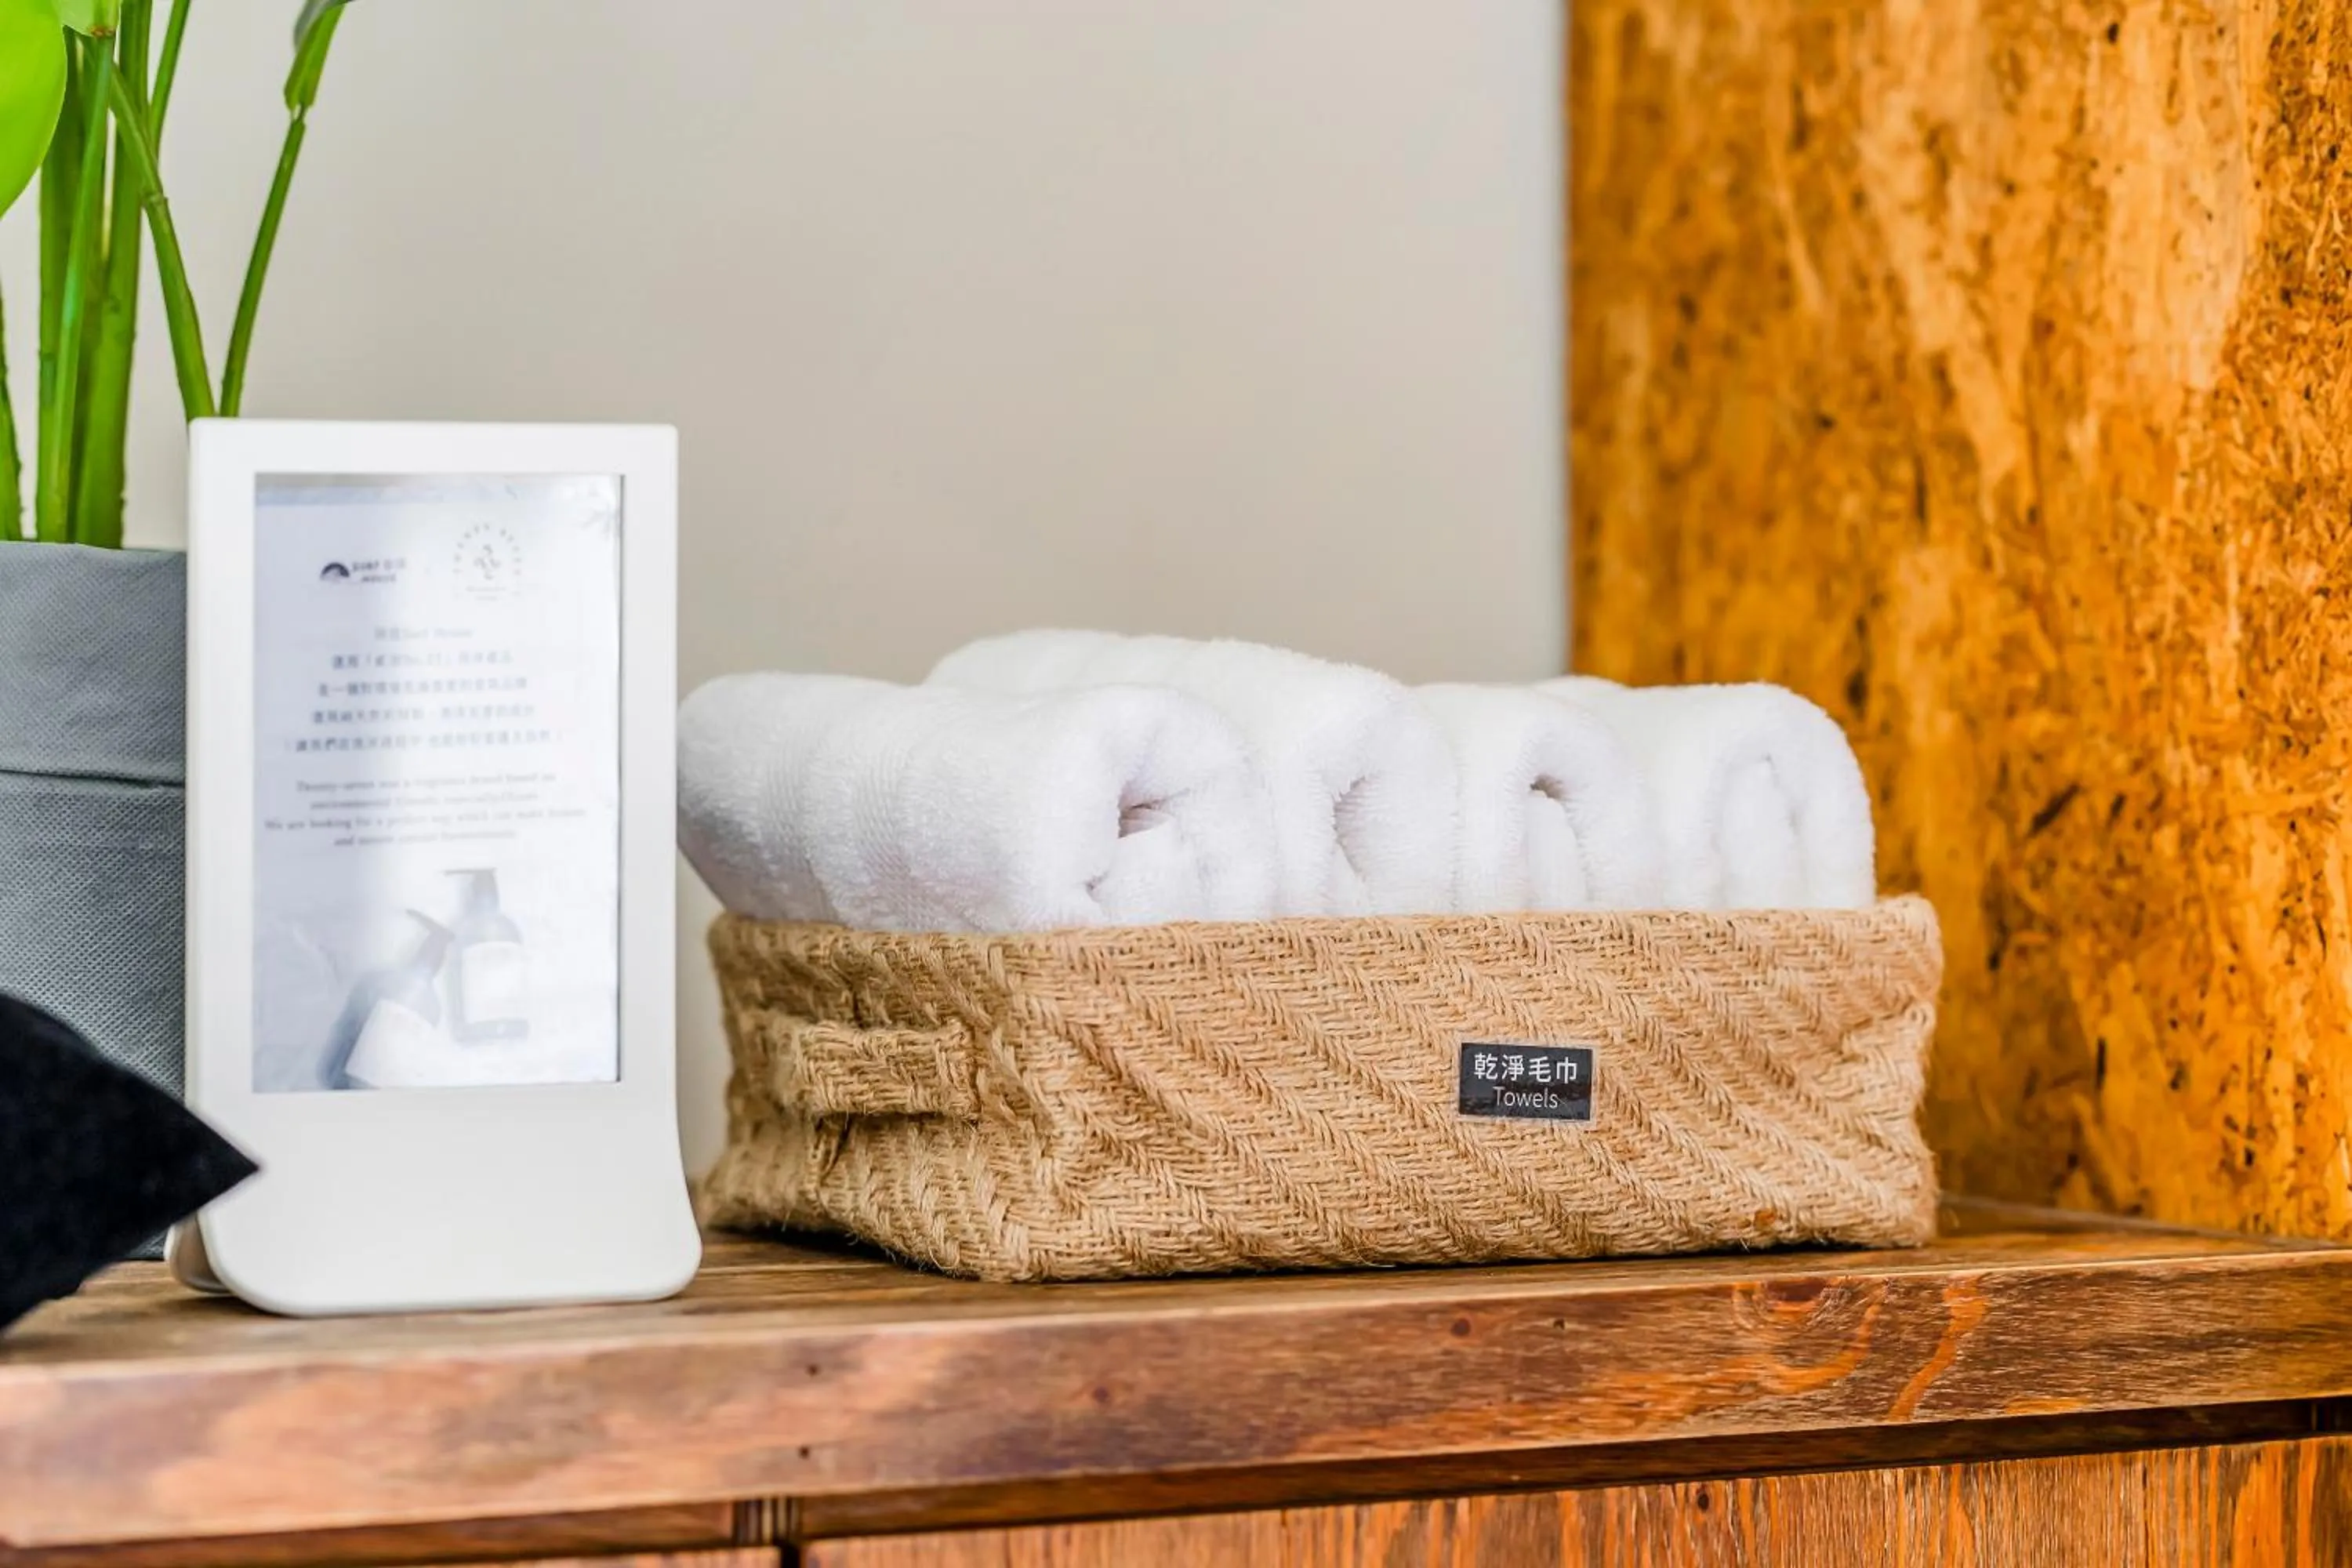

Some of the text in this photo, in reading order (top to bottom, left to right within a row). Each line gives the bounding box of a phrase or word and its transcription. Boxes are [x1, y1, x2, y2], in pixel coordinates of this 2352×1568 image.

[1474, 1052, 1578, 1084] 乾淨毛巾
[1493, 1086, 1559, 1109] Towels
